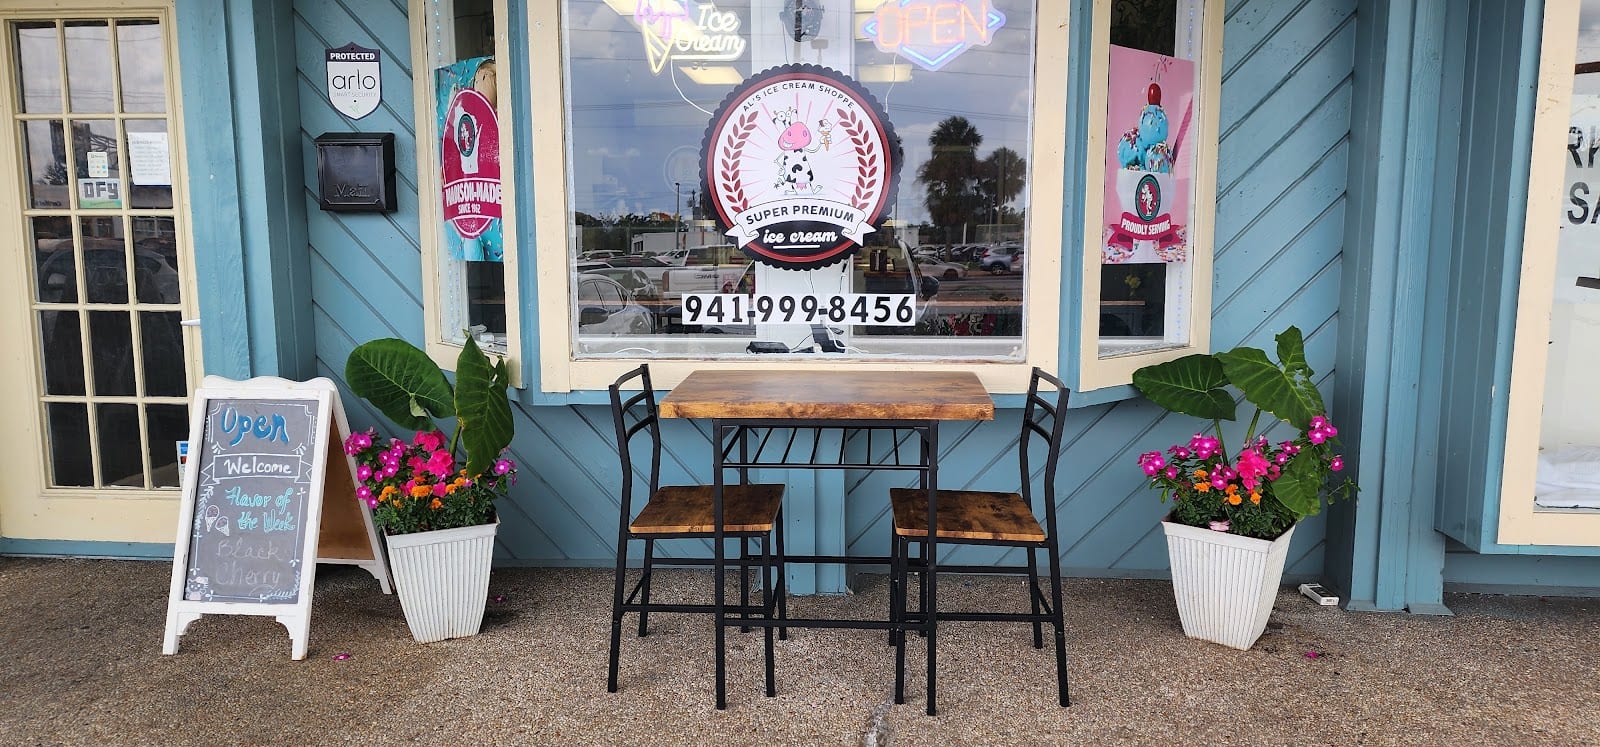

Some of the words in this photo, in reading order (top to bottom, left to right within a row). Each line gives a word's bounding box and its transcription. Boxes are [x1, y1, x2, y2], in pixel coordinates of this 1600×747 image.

[696, 4, 740, 32] Ice
[879, 0, 988, 48] OPEN
[676, 28, 745, 52] Cream
[330, 52, 376, 60] PROTECTED
[332, 69, 376, 90] arlo
[743, 94, 762, 112] AL'S
[763, 86, 780, 97] ICE
[782, 82, 816, 91] CREAM
[819, 86, 855, 109] SHOPPE
[445, 182, 502, 207] MADISON-MADE
[458, 203, 471, 214] SINCE
[746, 206, 789, 225] SUPER
[792, 205, 854, 223] PREMIUM
[763, 230, 786, 244] ice
[789, 230, 838, 244] cream
[1121, 218, 1148, 235] PROUDLY
[1148, 219, 1171, 235] SERVING
[685, 295, 914, 324] 941-999-8456
[222, 407, 290, 447] Open
[223, 455, 293, 475] Welcome
[225, 486, 273, 508] Flavor
[275, 487, 294, 516] of
[237, 511, 259, 531] the
[262, 509, 297, 534] Week
[216, 537, 284, 562] Black
[215, 560, 281, 591] Cherry
